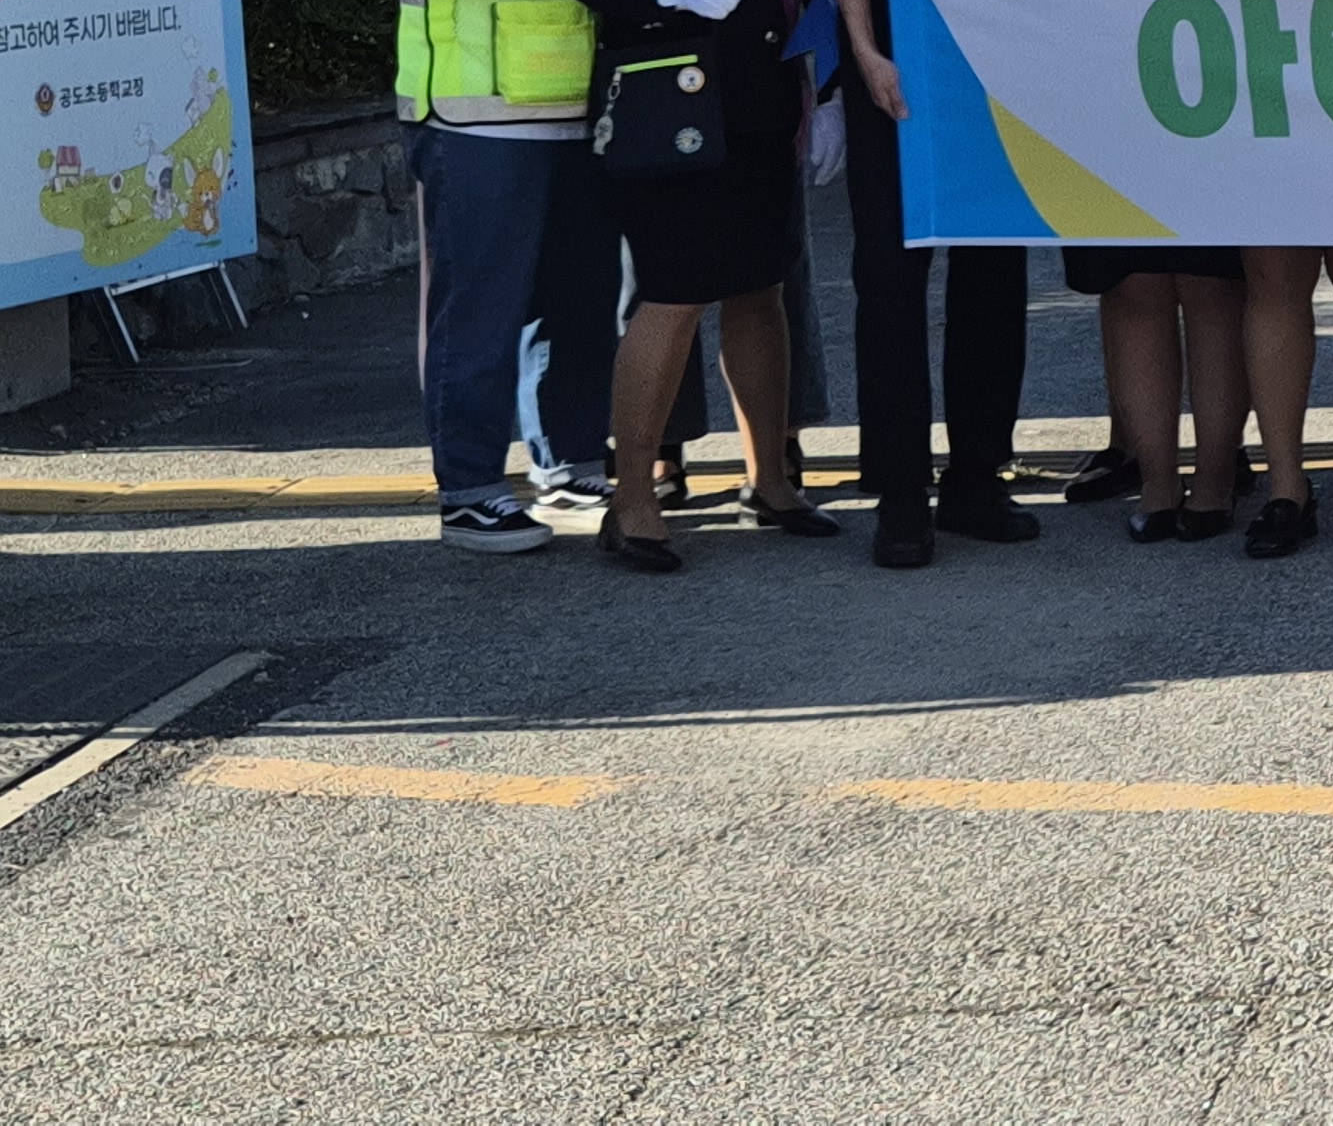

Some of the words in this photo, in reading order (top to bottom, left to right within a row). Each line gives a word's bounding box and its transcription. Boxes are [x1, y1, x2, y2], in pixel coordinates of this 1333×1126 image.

[63, 12, 112, 46] 주시기
[115, 4, 183, 37] 바랍니다.
[58, 76, 145, 109] 공도초등학교장
